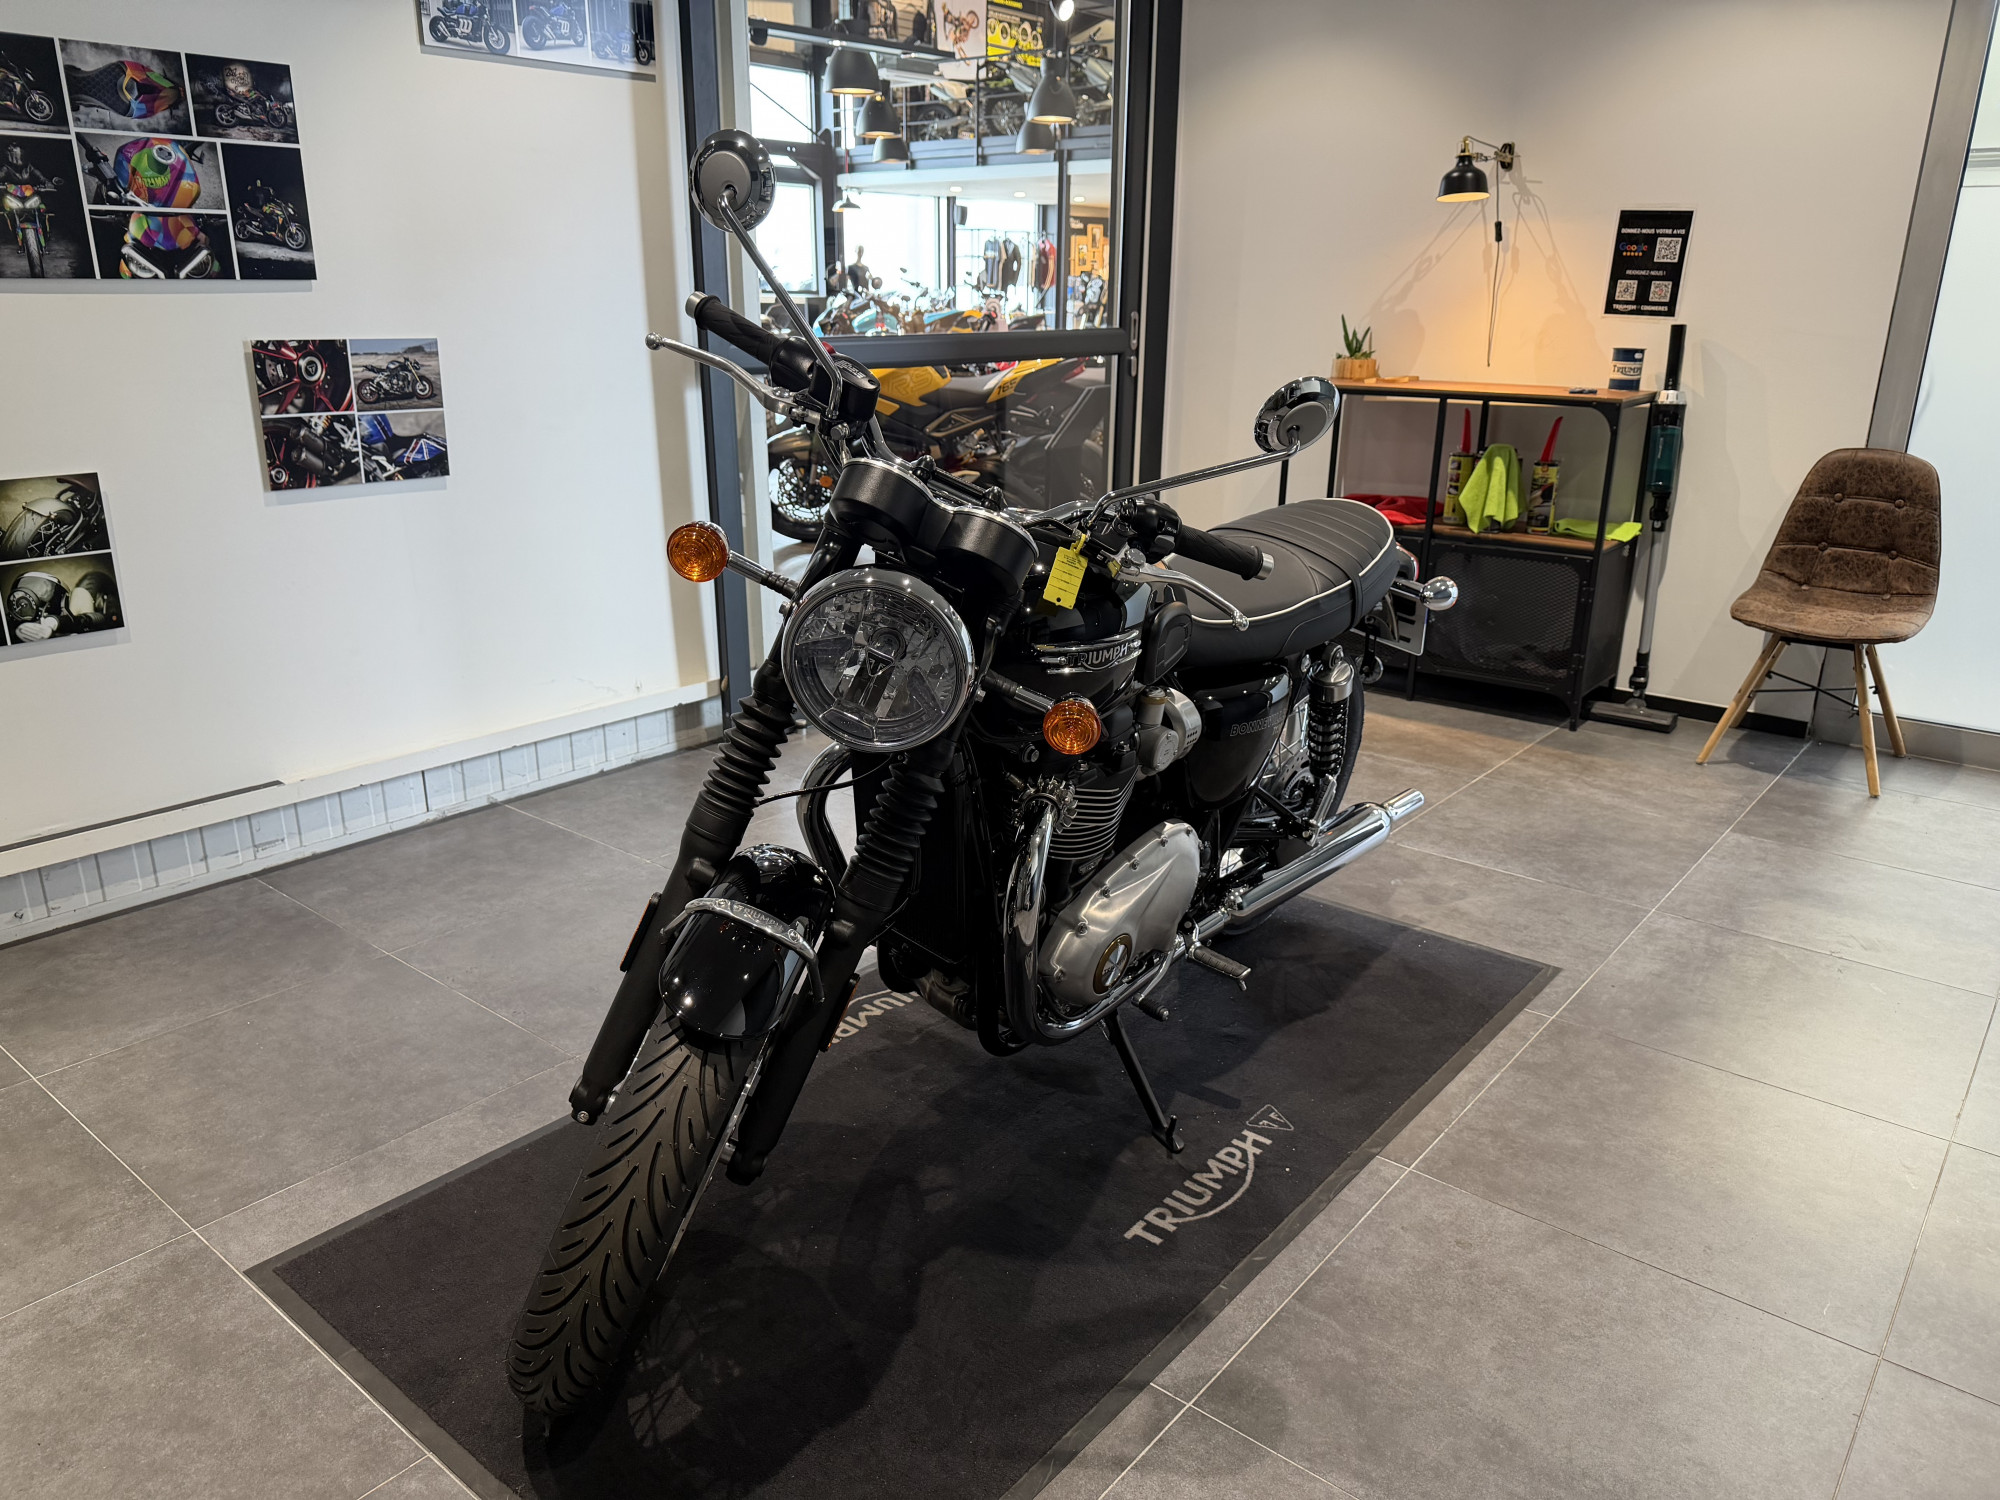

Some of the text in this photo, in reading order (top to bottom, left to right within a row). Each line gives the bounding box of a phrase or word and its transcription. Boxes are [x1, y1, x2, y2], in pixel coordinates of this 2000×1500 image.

[1619, 242, 1648, 253] Google
[888, 367, 934, 397] RS
[1068, 643, 1130, 670] TRIUMPH
[1123, 1129, 1273, 1246] TRIUMPH
